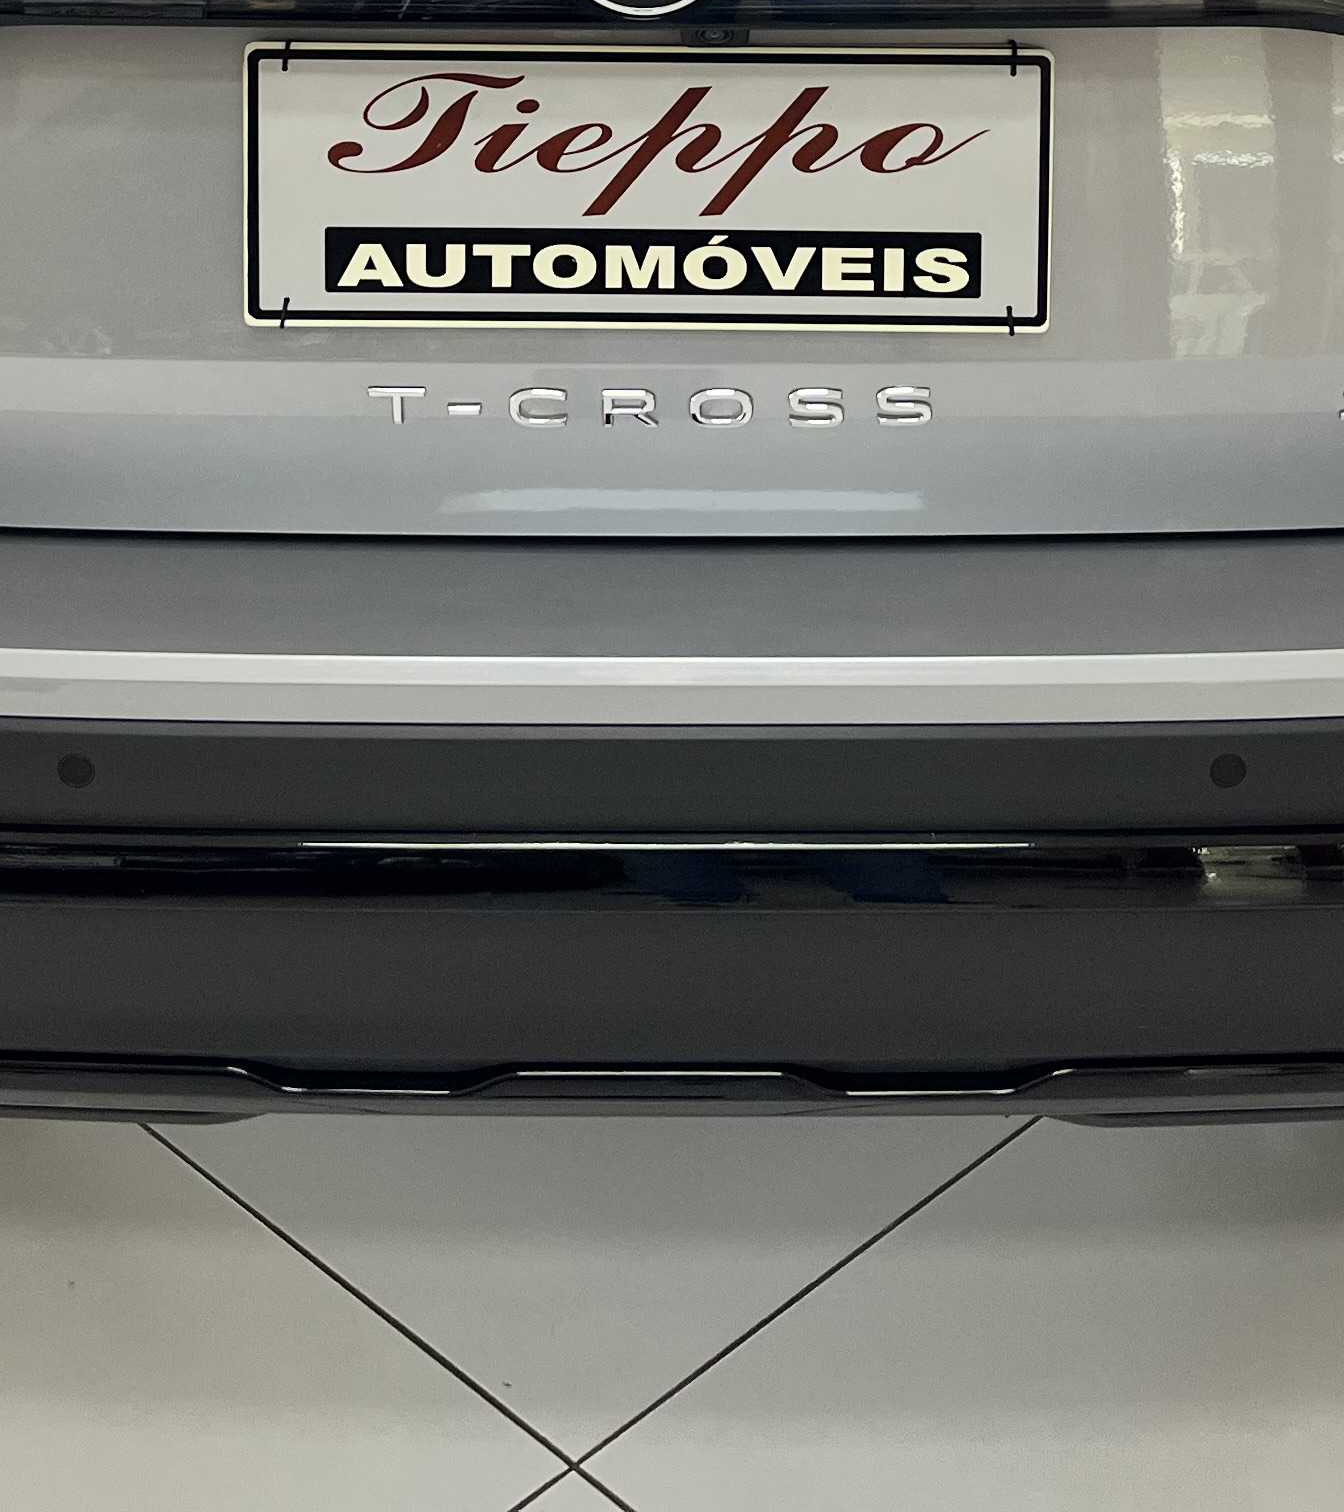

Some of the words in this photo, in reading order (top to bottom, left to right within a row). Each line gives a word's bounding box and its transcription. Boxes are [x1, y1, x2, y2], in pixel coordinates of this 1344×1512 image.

[326, 71, 991, 217] Tieppo
[336, 235, 971, 293] AUTOMÓVEIS
[367, 384, 935, 429] T-CROSS
